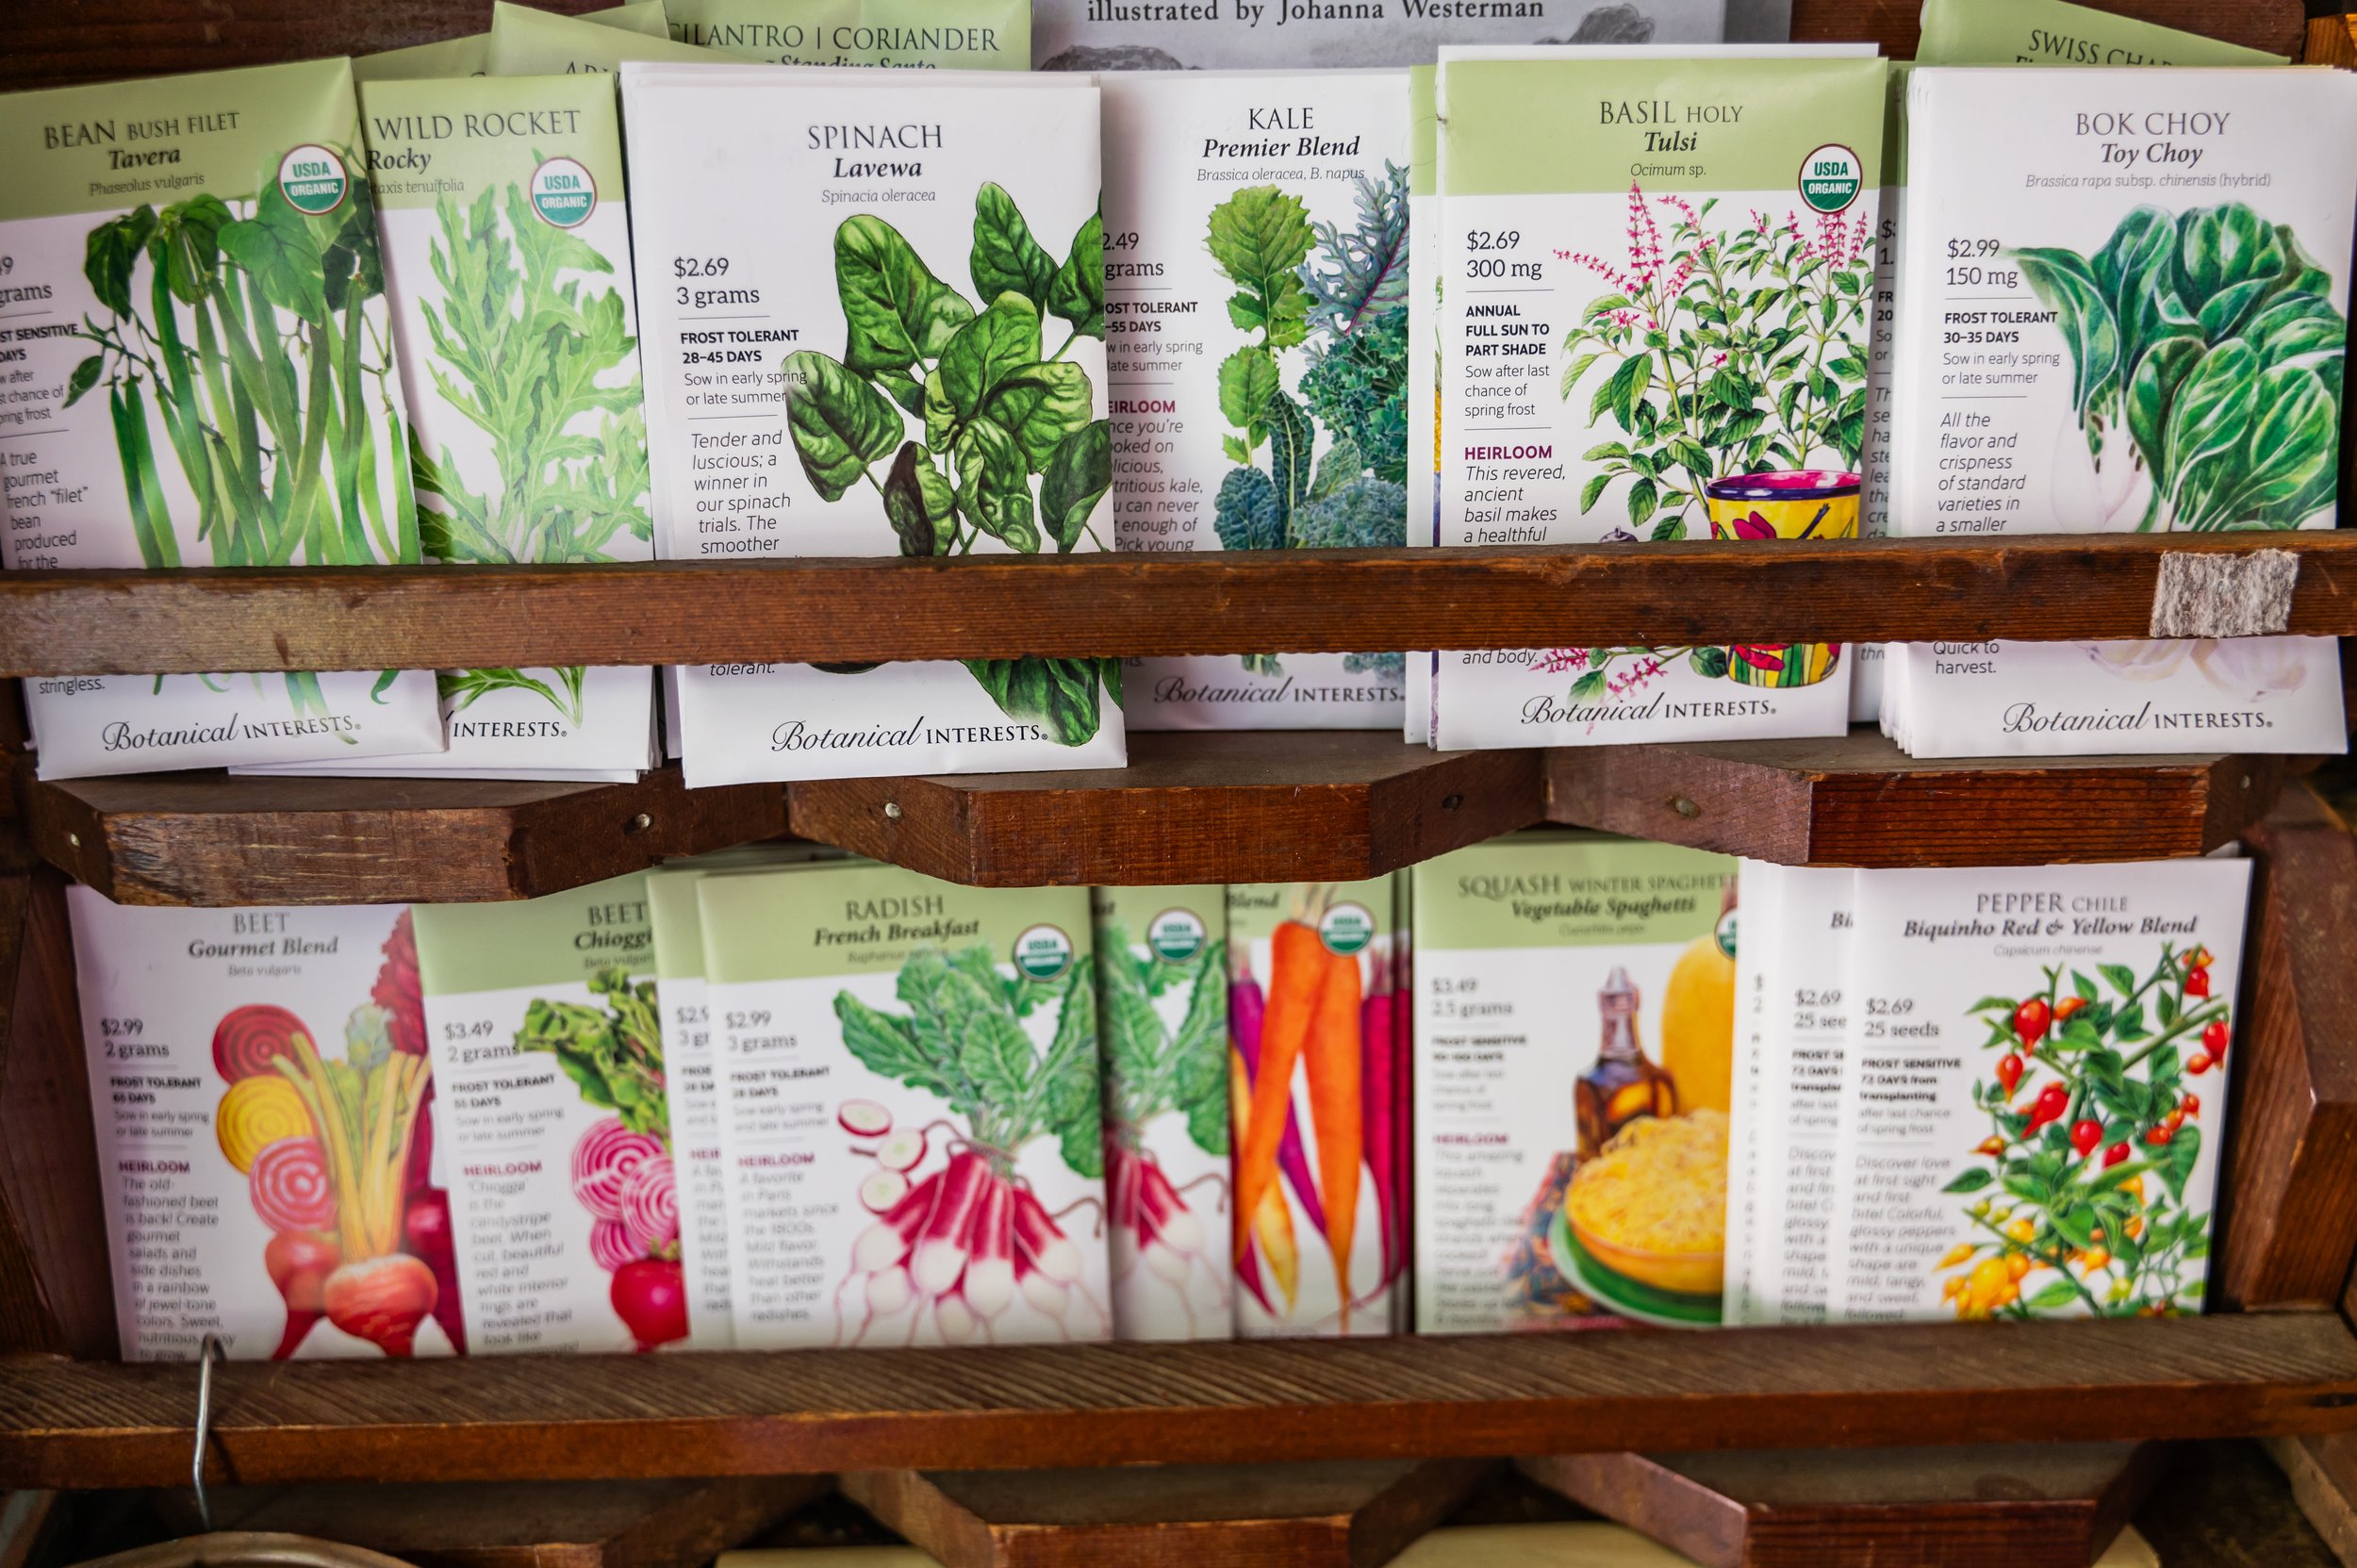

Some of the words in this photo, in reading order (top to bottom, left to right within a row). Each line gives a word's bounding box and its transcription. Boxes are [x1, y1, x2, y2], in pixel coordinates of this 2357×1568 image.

[1087, 0, 1219, 22] illustrated
[1236, 0, 1264, 27] by
[1277, 0, 1384, 25] Johanna
[1402, 0, 1544, 19] Westerman
[833, 26, 1001, 52] CORIANDER
[1248, 107, 1314, 130] KALE
[1600, 101, 1675, 124] BASIL
[1687, 106, 1743, 124] HOLY
[44, 121, 116, 149] BEAN
[127, 119, 180, 141] BUSH
[188, 112, 239, 133] FILET
[374, 116, 453, 140] WILD
[464, 110, 581, 138] ROCKET
[2075, 112, 2136, 136] BOK
[2145, 112, 2231, 136] CHOY
[808, 124, 943, 149] SPINACH
[1644, 131, 1697, 152] Tulsi
[1202, 139, 1291, 158] Premier
[1296, 136, 1360, 157] Blend
[2102, 142, 2139, 169] Toy
[2146, 141, 2203, 169] Choy
[108, 148, 181, 171] Tavera
[368, 148, 431, 174] Rocky
[832, 157, 923, 178] Lavewa
[291, 162, 332, 178] USDA
[1197, 168, 1249, 182] Brassica
[1252, 167, 1307, 182] oleracea,
[1310, 168, 1323, 180] B.
[1326, 168, 1365, 182] napus
[1630, 163, 1685, 176] Ocimum
[1689, 166, 1706, 178] sp.
[1814, 162, 1849, 176] USDA
[90, 175, 153, 196] Phaseolus
[156, 172, 205, 192] vulgaris
[289, 182, 338, 197] ORGANIC
[405, 178, 465, 195] tenuifolia
[544, 175, 581, 190] USDA
[1808, 183, 1852, 194] ORGANIC
[2025, 174, 2079, 188] Brassica
[2082, 177, 2111, 190] rapa
[2116, 173, 2156, 190] subsp.
[2159, 174, 2217, 188] chinensis
[2219, 173, 2271, 190] (hybrid)
[541, 197, 587, 208] ORGANIC
[822, 190, 879, 206] Spinacia
[882, 189, 935, 203] oleracea
[1467, 230, 1520, 253] $2.69
[1947, 238, 2000, 260] $2.99
[674, 256, 729, 279] $2.69
[1466, 259, 1505, 278] 300
[1511, 262, 1542, 281] mg
[1946, 267, 1982, 285] 150
[1987, 271, 2018, 289] mg
[677, 287, 689, 305] 3
[695, 289, 760, 308] grams
[1466, 305, 1521, 317] ANNUAL
[1945, 313, 1987, 324] FROST
[1990, 312, 2058, 323] TOLERANT
[681, 332, 724, 344] FROST
[728, 329, 799, 343] TOLERANT
[1466, 325, 1497, 337] FULL
[1501, 324, 1528, 336] SUN
[1532, 323, 1550, 336] TO
[1986, 332, 2019, 342] DAYS
[727, 351, 762, 362] DAYS
[1465, 344, 1499, 356] PART
[1502, 343, 1546, 355] SHADE
[1465, 365, 1492, 378] Sow
[1496, 364, 1525, 377] after
[1528, 364, 1550, 376] last
[1465, 386, 1510, 397] chance
[1514, 384, 1527, 396] of
[1465, 404, 1504, 419] spring
[1508, 404, 1535, 416] frost
[1940, 412, 1961, 427] All
[1966, 412, 1990, 427] the
[691, 432, 748, 449] Tender
[751, 430, 783, 445] and
[1940, 434, 1984, 449] flavor
[1987, 433, 2018, 448] and
[1465, 445, 1552, 460] HEIRLOOM
[693, 454, 764, 470] luscious;
[1939, 454, 2012, 472] crispness
[4, 470, 59, 491] gourmet
[1466, 466, 1498, 481] This
[1503, 464, 1566, 481] revered,
[694, 476, 750, 491] winner
[753, 474, 767, 487] in
[1938, 475, 1956, 490] of
[1957, 474, 2026, 490] standard
[7, 491, 46, 508] french
[696, 499, 723, 513] our
[728, 492, 791, 513] spinach
[1464, 487, 1524, 502] ancient
[1126, 502, 1152, 512] can
[1157, 502, 1199, 512] never
[1937, 497, 2002, 511] varieties
[2006, 496, 2019, 510] in
[1464, 507, 1501, 522] basil
[1506, 506, 1558, 521] makes
[699, 517, 741, 533] trials.
[747, 515, 777, 530] The
[1122, 520, 1178, 536] enough
[1950, 517, 2007, 532] smaller
[15, 530, 77, 552] produced
[1478, 526, 1547, 543] healthful
[701, 536, 779, 554] smoother
[1462, 651, 1492, 665] and
[1496, 649, 1539, 666] body.
[1935, 659, 1997, 675] harvest.
[39, 677, 105, 695] stringless.
[1154, 676, 1294, 703] Botanical
[1521, 692, 1664, 724] Botanical
[2003, 701, 2152, 734] Botanical
[102, 713, 239, 751] Botanical
[772, 716, 925, 752] Botanical
[1458, 875, 1561, 902] SQUASH
[846, 896, 945, 922] RADISH
[1511, 898, 1600, 924] Vegetable
[1606, 896, 1696, 919] Spaghetti
[1975, 893, 2065, 915] PEPPER
[2072, 897, 2128, 913] CHILE
[587, 901, 648, 926] BEET
[233, 912, 290, 934] BEET
[1904, 919, 1995, 942] Biquinho
[2002, 918, 2047, 935] Red
[2046, 921, 2064, 934] &
[2072, 917, 2133, 935] Yellow
[2140, 916, 2199, 934] Blend
[815, 925, 881, 947] French
[888, 920, 980, 942] Breakfast
[189, 939, 275, 958] Gourmet
[283, 937, 338, 955] Blend
[1866, 998, 1914, 1015] $2.69
[102, 1018, 143, 1035] $2.99
[1864, 1021, 1885, 1037] 25
[1890, 1023, 1939, 1037] seeds
[119, 1044, 170, 1061] grams
[119, 1161, 190, 1173] HEIRLOOM
